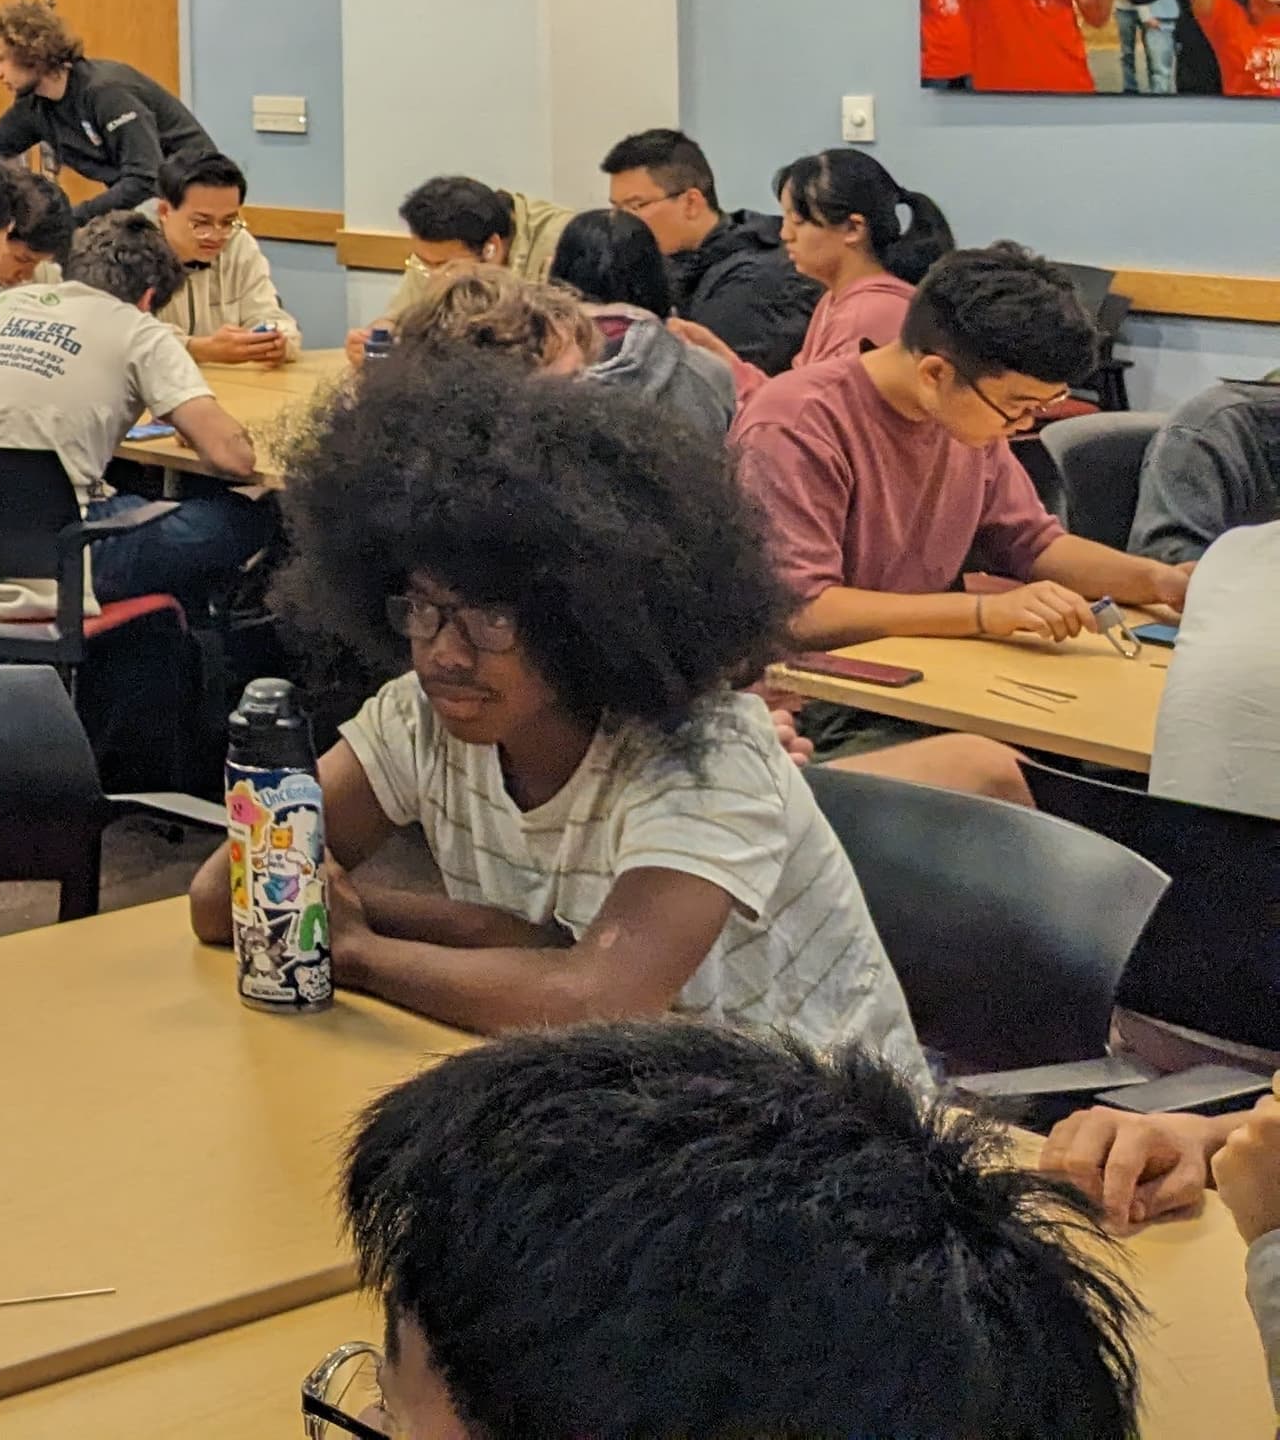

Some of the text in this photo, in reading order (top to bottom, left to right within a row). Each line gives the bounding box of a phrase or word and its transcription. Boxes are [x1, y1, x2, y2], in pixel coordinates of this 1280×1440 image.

[7, 317, 76, 337] LET'S GET
[0, 327, 82, 356] CONNECTED
